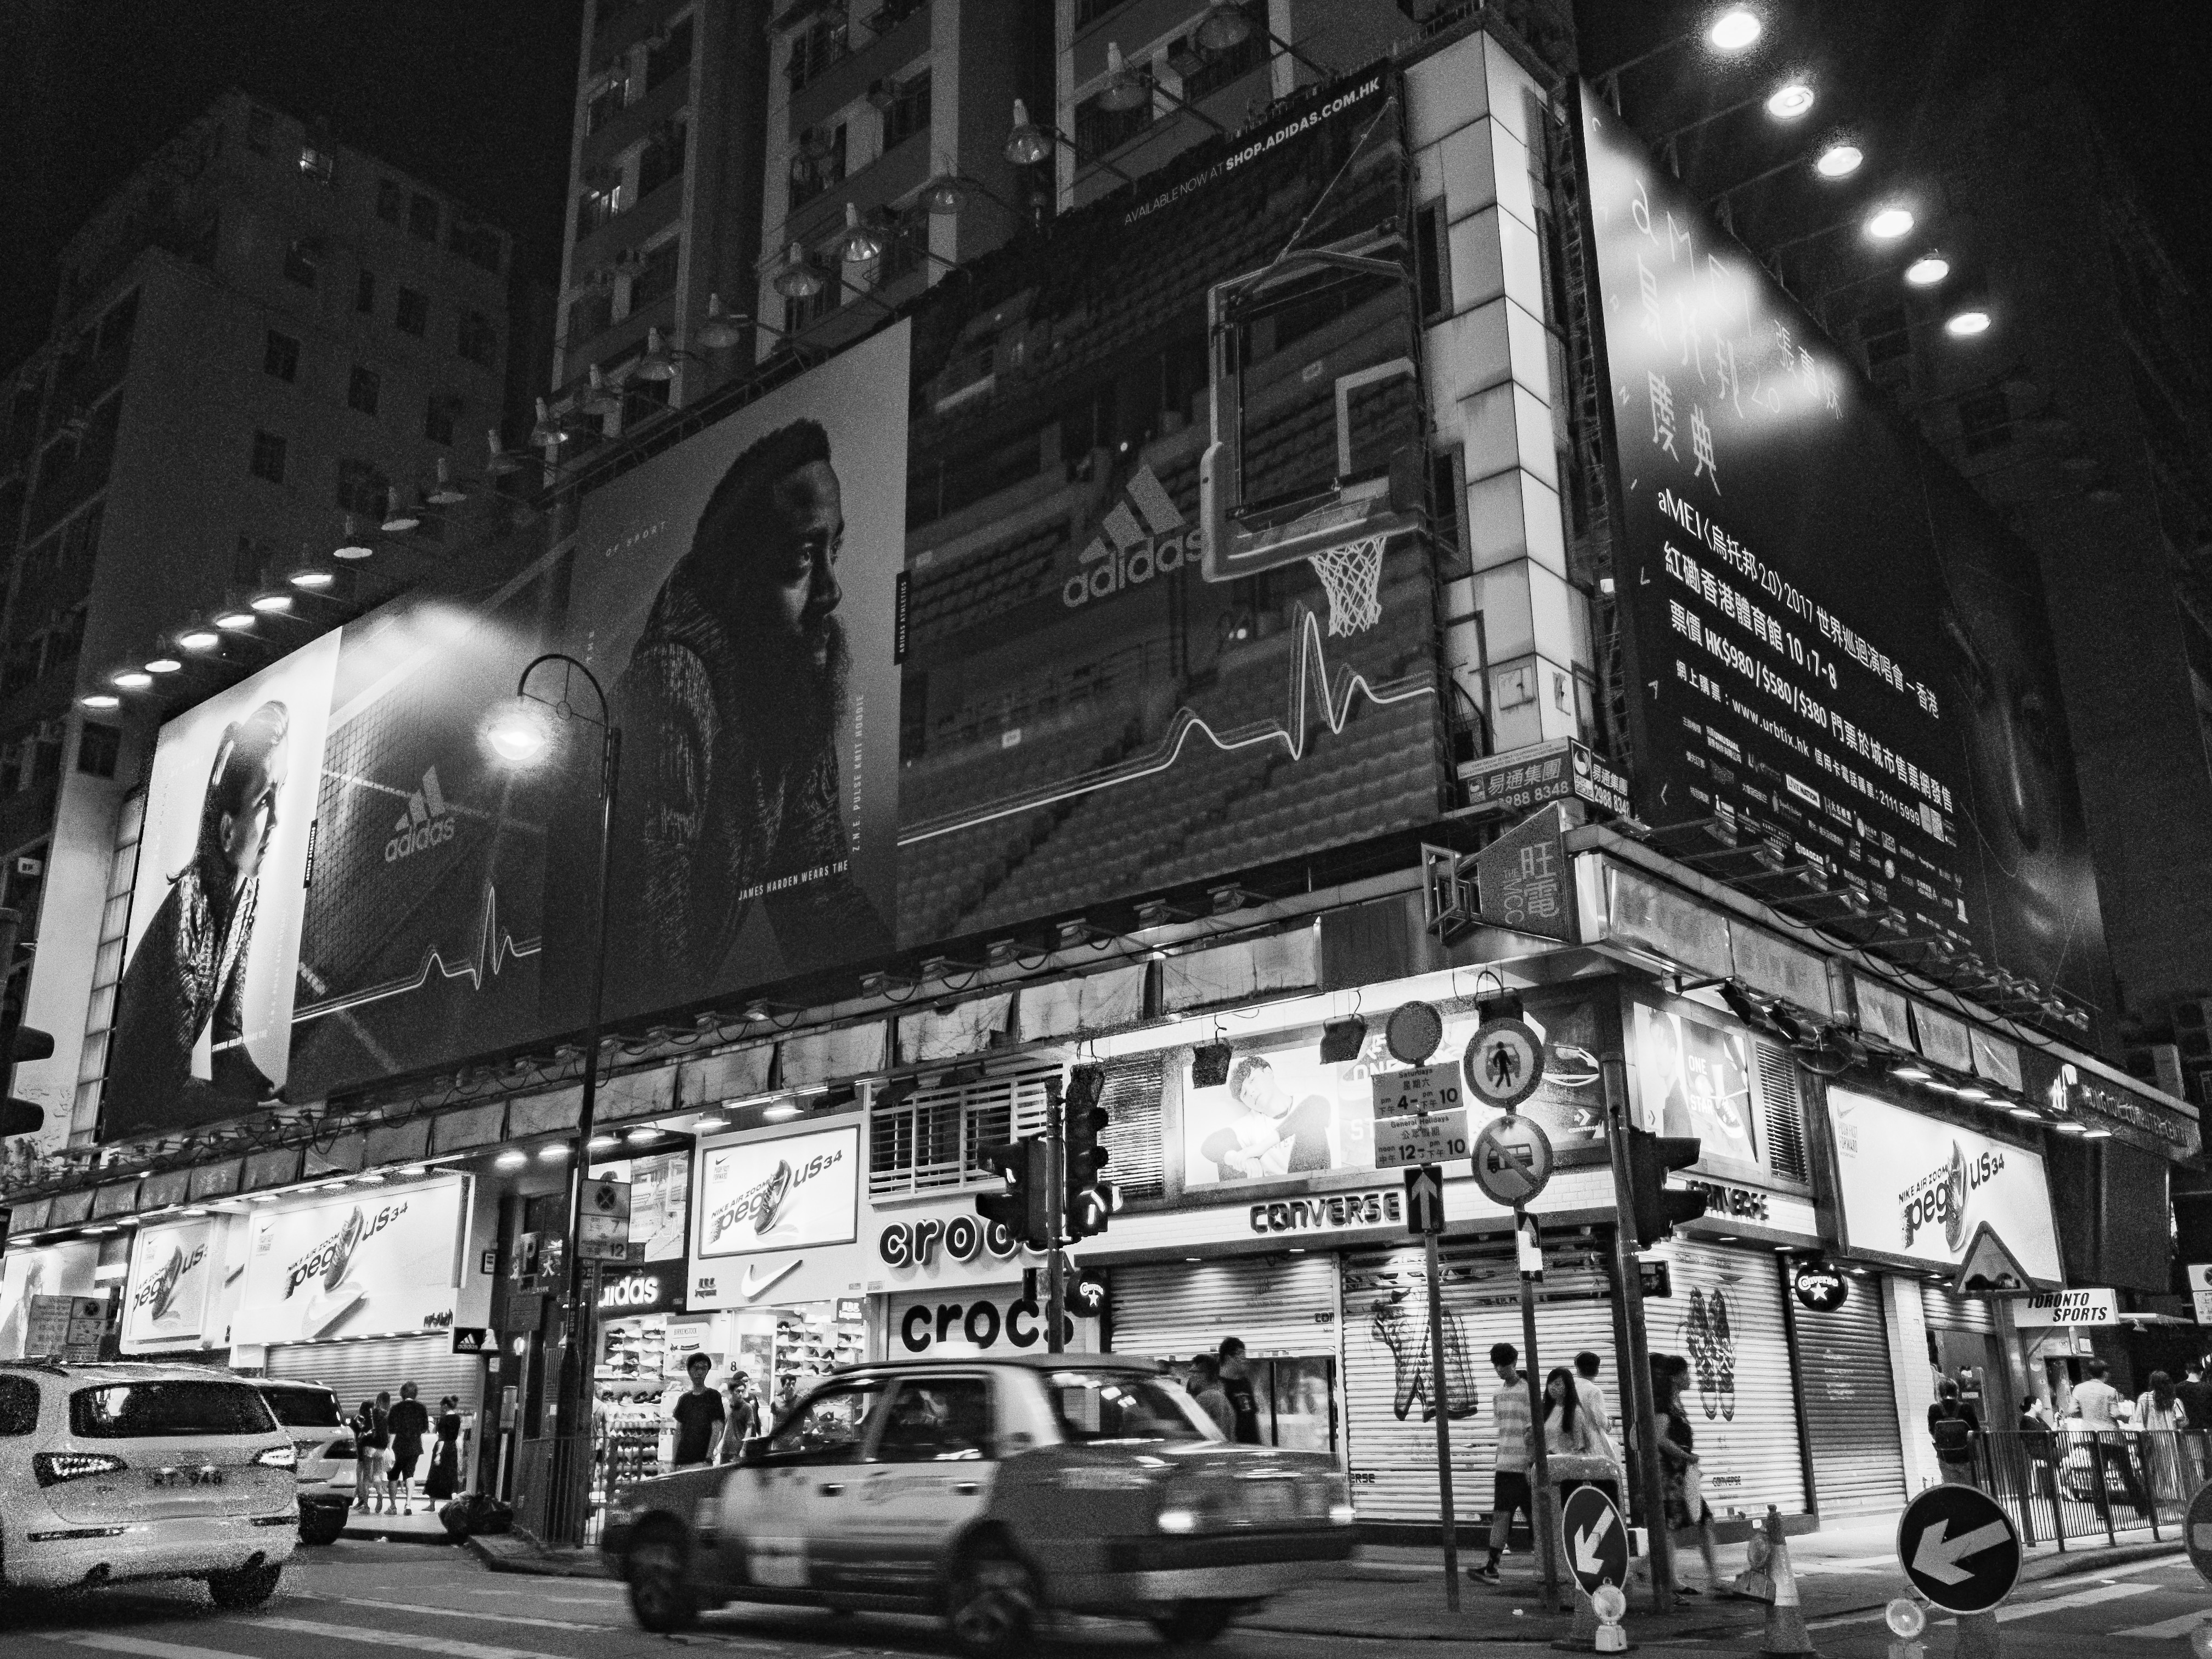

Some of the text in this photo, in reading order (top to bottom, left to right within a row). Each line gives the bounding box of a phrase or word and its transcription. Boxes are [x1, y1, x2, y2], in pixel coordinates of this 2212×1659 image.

[1124, 77, 1380, 225] AVAILABLE NOW AT SHOP.ADIDAS.COM.HK
[1063, 528, 1203, 607] adidas
[1663, 541, 1784, 654] 紅磡香港體育館
[856, 694, 864, 737] HOODIE
[1669, 599, 1702, 646] 票價
[1831, 710, 1954, 814] 門票於城市售票網發售
[854, 743, 862, 770] KNIT
[1488, 758, 1562, 795] 易通集團
[1592, 763, 1628, 797] 易通集團
[1788, 779, 1801, 791] LIVE
[854, 774, 862, 811] PULSE
[1534, 781, 1569, 799] 8348
[1594, 785, 1612, 809] 2988
[1613, 794, 1630, 818] 8348
[1900, 806, 1921, 826] 5999
[385, 816, 455, 863] adidas
[738, 860, 848, 901] JAMES HARDEN WEARS THE
[1504, 867, 1520, 879] THE
[1520, 840, 1560, 918] 旺電
[1399, 1068, 1433, 1079] Saturdays
[1688, 1054, 1707, 1076] ONE
[1403, 1078, 1430, 1091] 星期六
[1440, 1088, 1458, 1104] 10
[1690, 1094, 1714, 1115] STAR
[1379, 1099, 1437, 1115] 下午 下午
[1390, 1116, 1449, 1128] General Holidays
[1379, 1149, 1443, 1164] 中午 下午
[1447, 1138, 1465, 1155] 10
[1898, 1164, 1948, 1205] NIKE AIR ZOOM
[712, 1180, 769, 1219] NIKE AIR ZOOM
[1250, 1192, 1401, 1234] CONVERSE
[611, 1220, 620, 1233] 7
[610, 1243, 624, 1257] 12
[878, 1214, 1049, 1268] croc
[1798, 1276, 1838, 1291] Converse
[2028, 1291, 2090, 1310] TORONTO
[2052, 1306, 2108, 1323] SPORTS
[731, 1361, 736, 1372] 8
[1712, 1476, 1741, 1487] CONVERSE
